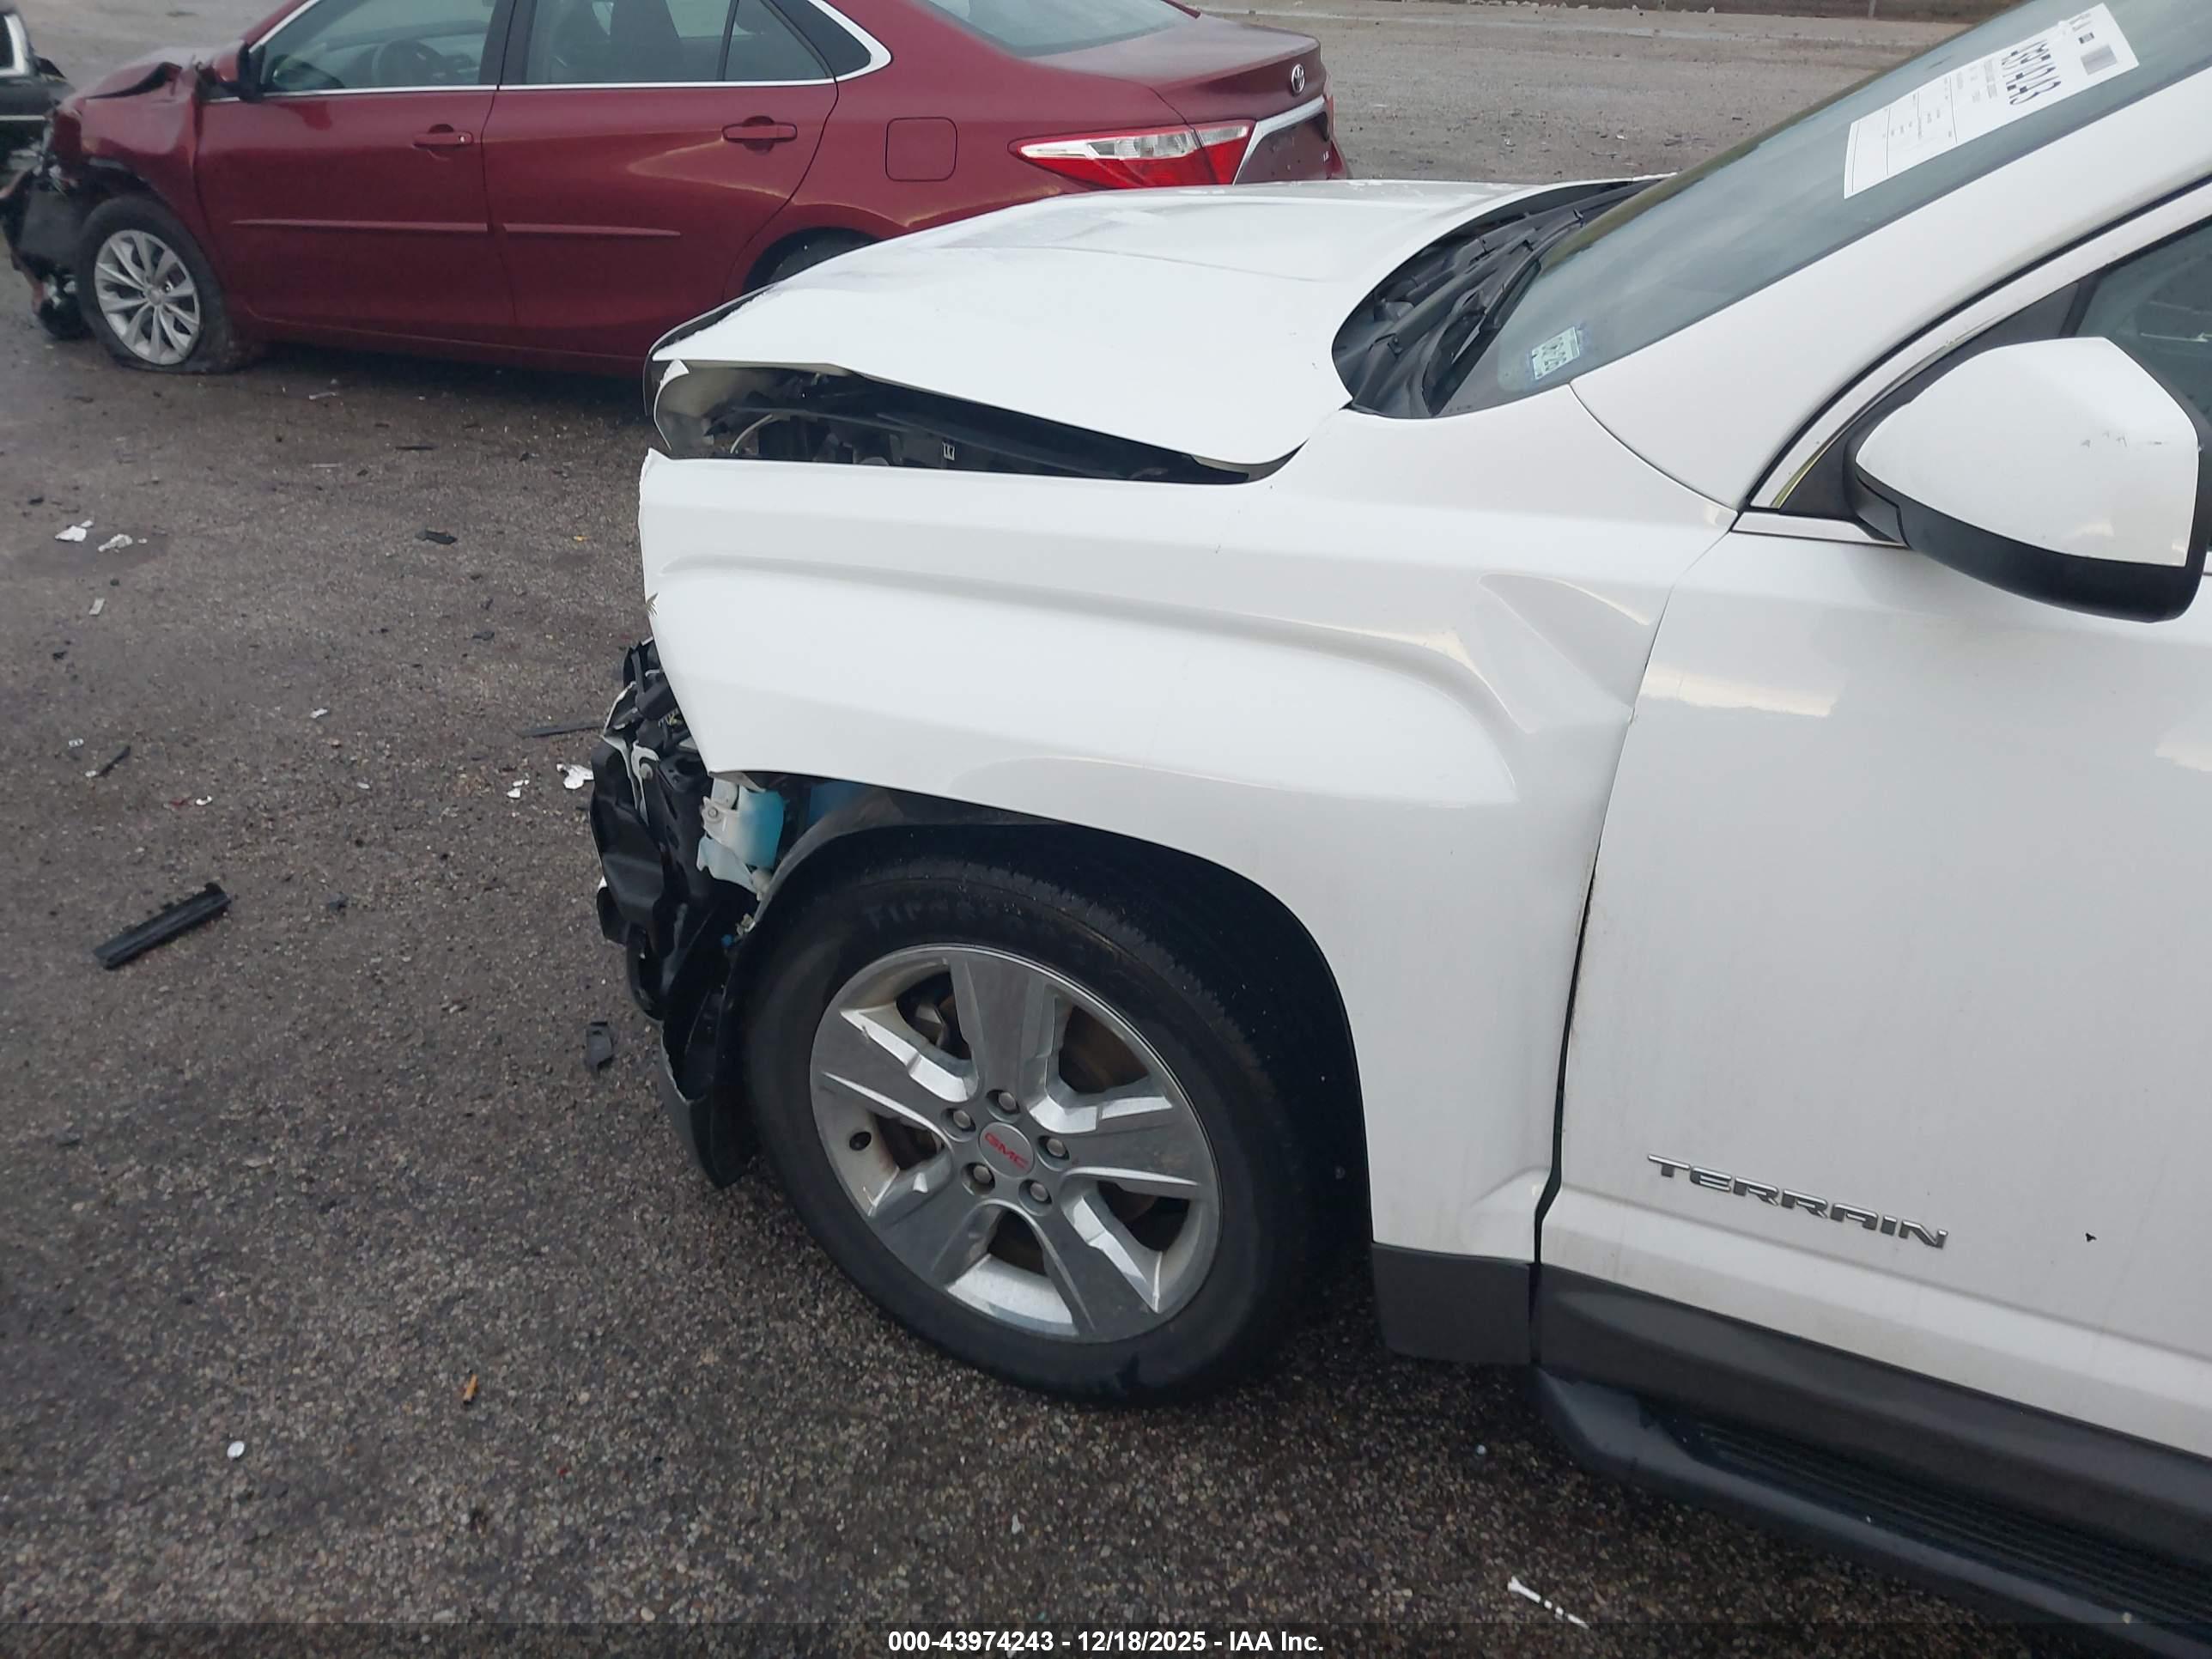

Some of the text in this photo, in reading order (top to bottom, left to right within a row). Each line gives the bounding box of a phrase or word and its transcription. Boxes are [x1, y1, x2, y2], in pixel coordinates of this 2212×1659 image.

[2001, 39, 2062, 106] 43974243
[984, 1132, 1030, 1170] GMC
[1647, 1153, 1948, 1249] TERRAIN
